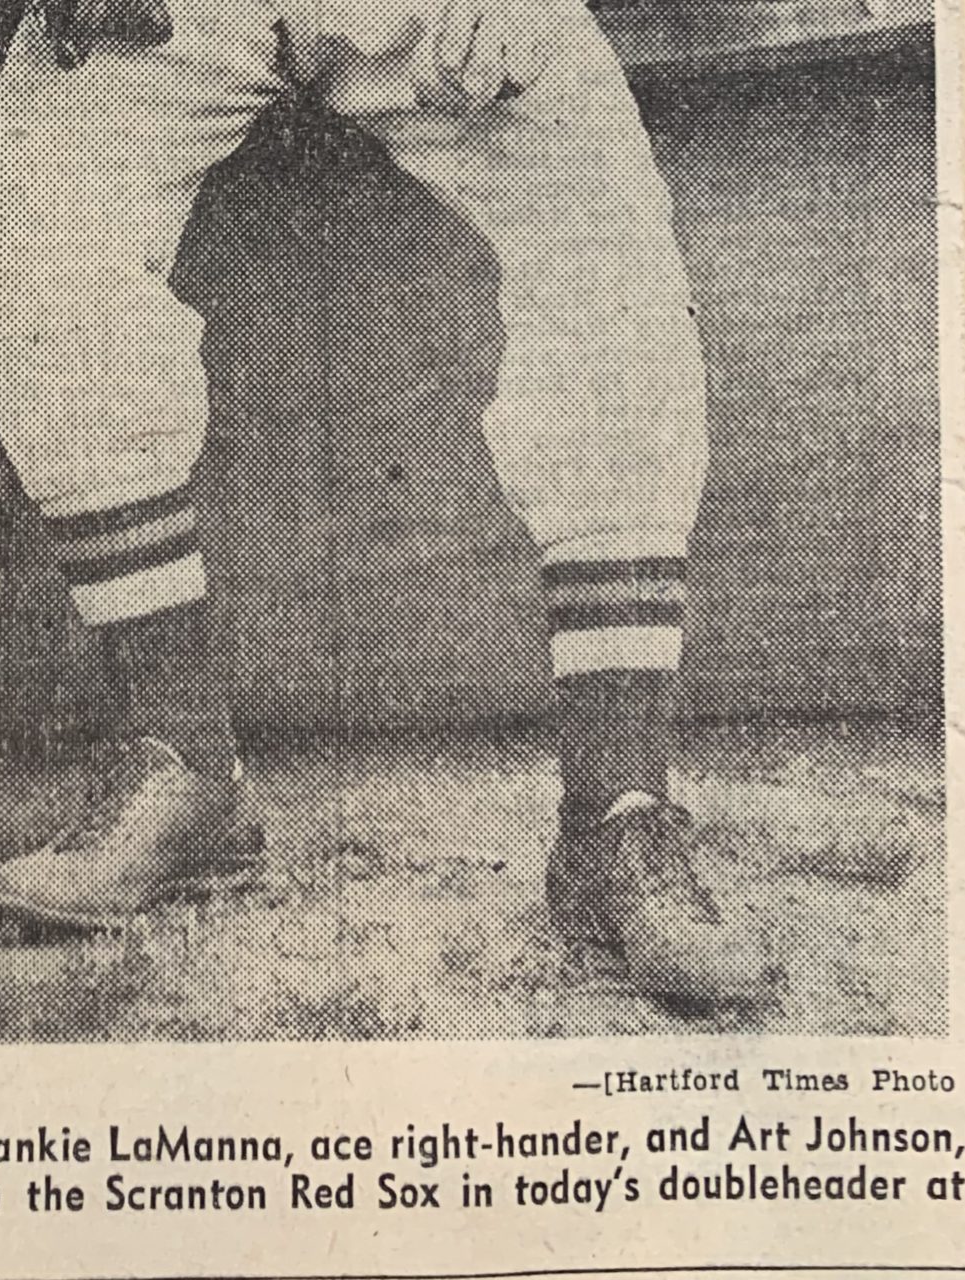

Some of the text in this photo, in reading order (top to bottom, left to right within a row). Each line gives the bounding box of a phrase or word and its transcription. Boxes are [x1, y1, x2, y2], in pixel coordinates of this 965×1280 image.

[762, 1068, 849, 1092] Times
[872, 1069, 956, 1093] Photo
[110, 1125, 293, 1166] LaManna,
[311, 1136, 372, 1161] ace
[392, 1119, 630, 1166] right-hander,
[646, 1115, 709, 1153] and
[728, 1115, 790, 1151] Art
[806, 1116, 965, 1159] Johnson,
[27, 1175, 84, 1212] the
[106, 1174, 266, 1211] Scranton
[291, 1173, 354, 1209] Red
[378, 1173, 440, 1209] Sox
[462, 1172, 492, 1208] in
[515, 1167, 640, 1212] today's
[659, 1163, 906, 1201] doubleheader
[927, 1171, 965, 1201] at
